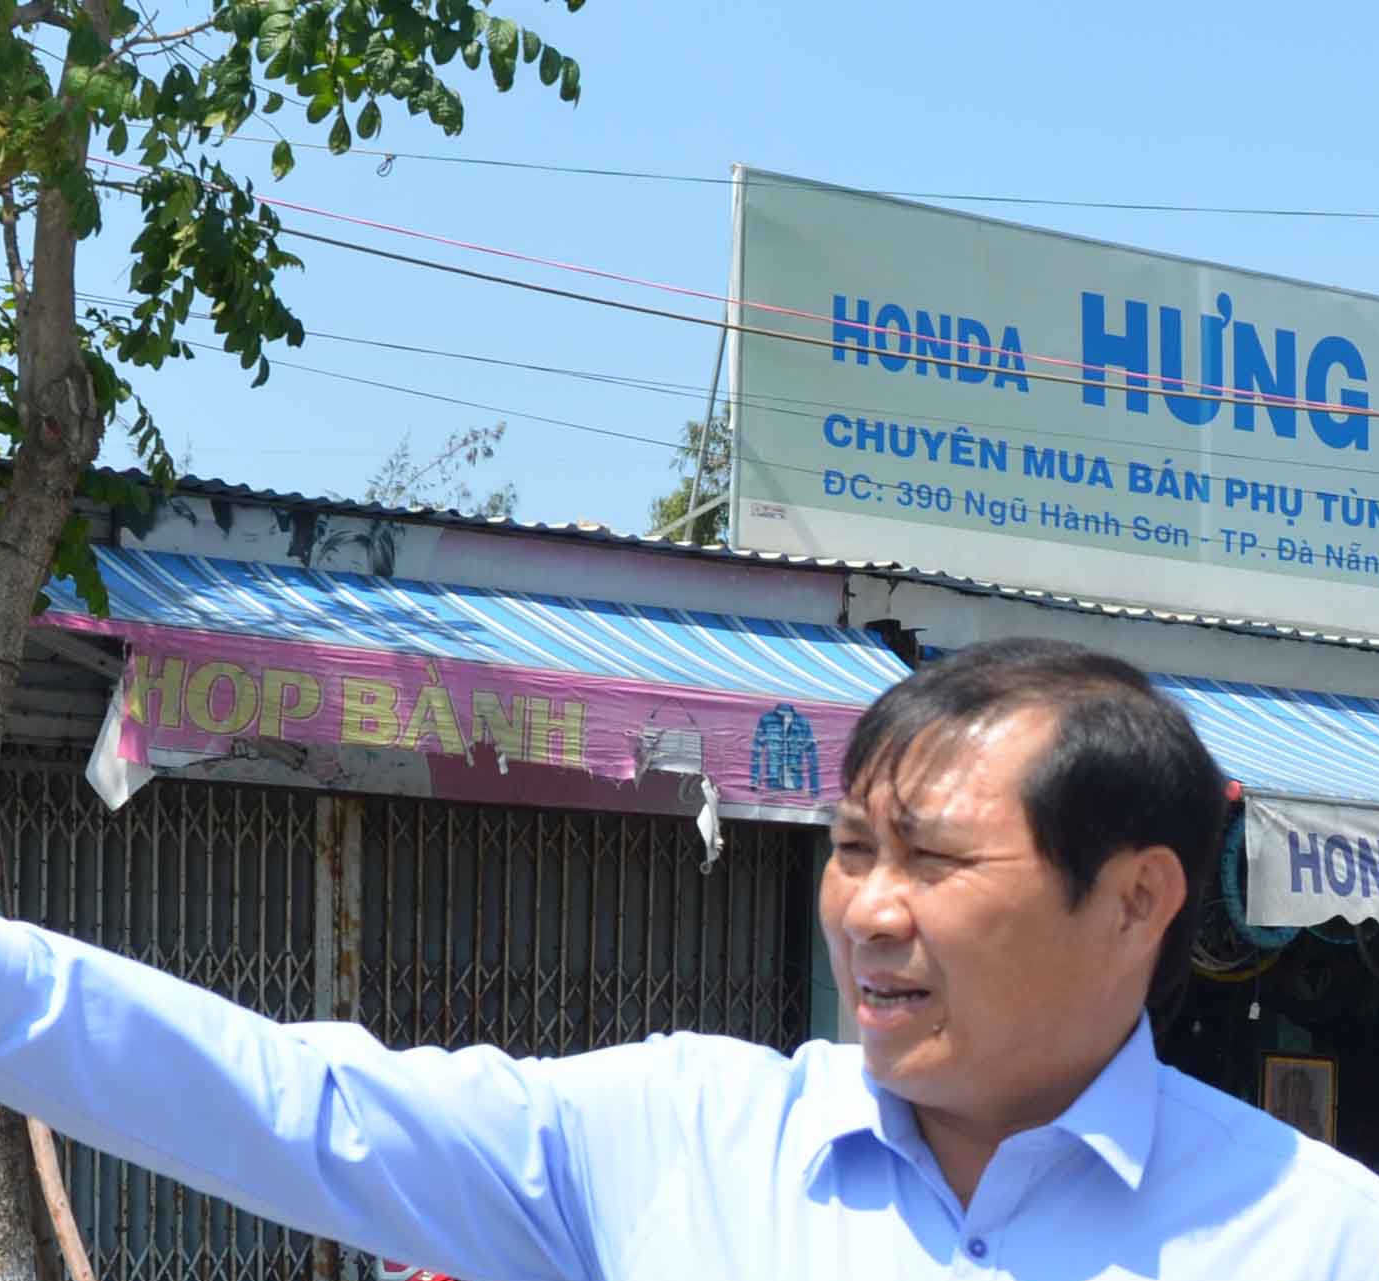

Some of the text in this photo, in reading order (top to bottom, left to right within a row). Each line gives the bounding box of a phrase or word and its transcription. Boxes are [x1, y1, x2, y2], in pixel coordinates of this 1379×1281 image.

[832, 295, 1029, 392] HONDA
[1082, 291, 1369, 451] HƯNG
[823, 413, 1007, 473] CHUYÊN
[1023, 445, 1113, 488] MUA
[1129, 459, 1210, 503] BÁN
[1225, 478, 1303, 526] PHỤ
[823, 470, 884, 501] ĐC:
[896, 482, 952, 512] 390
[965, 490, 1027, 526] Ngũ
[1041, 501, 1120, 537] Hành
[1133, 516, 1189, 547] Sơn
[1220, 528, 1267, 558] TP.
[1278, 536, 1313, 564] Đà
